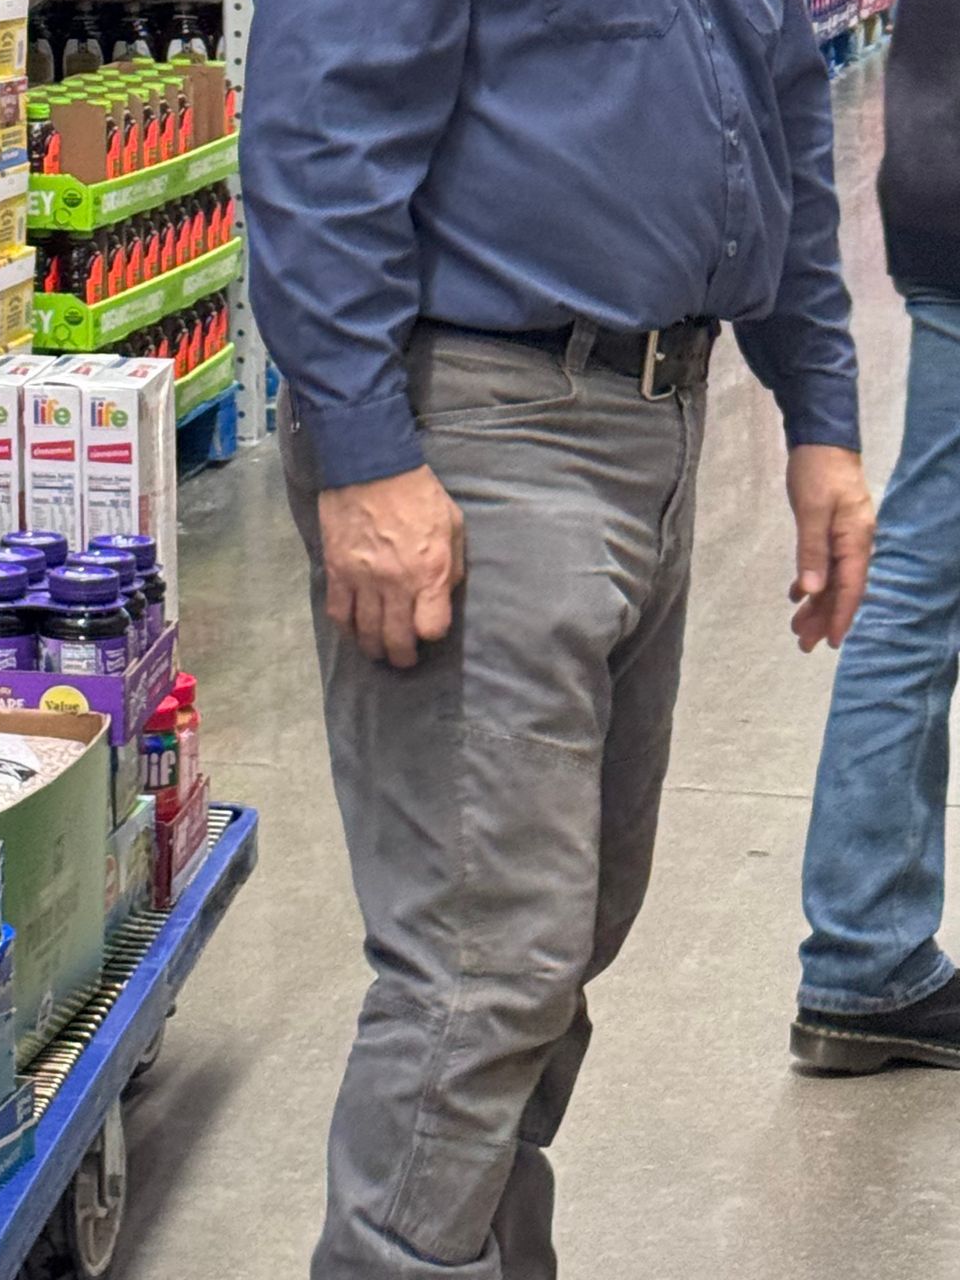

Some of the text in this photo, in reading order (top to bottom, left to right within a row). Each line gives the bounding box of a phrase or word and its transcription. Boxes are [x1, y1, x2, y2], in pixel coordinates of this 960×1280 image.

[33, 397, 72, 426] life
[90, 400, 129, 428] life
[33, 446, 72, 457] cinnamon
[89, 448, 130, 459] cinnamon
[45, 699, 80, 714] Value
